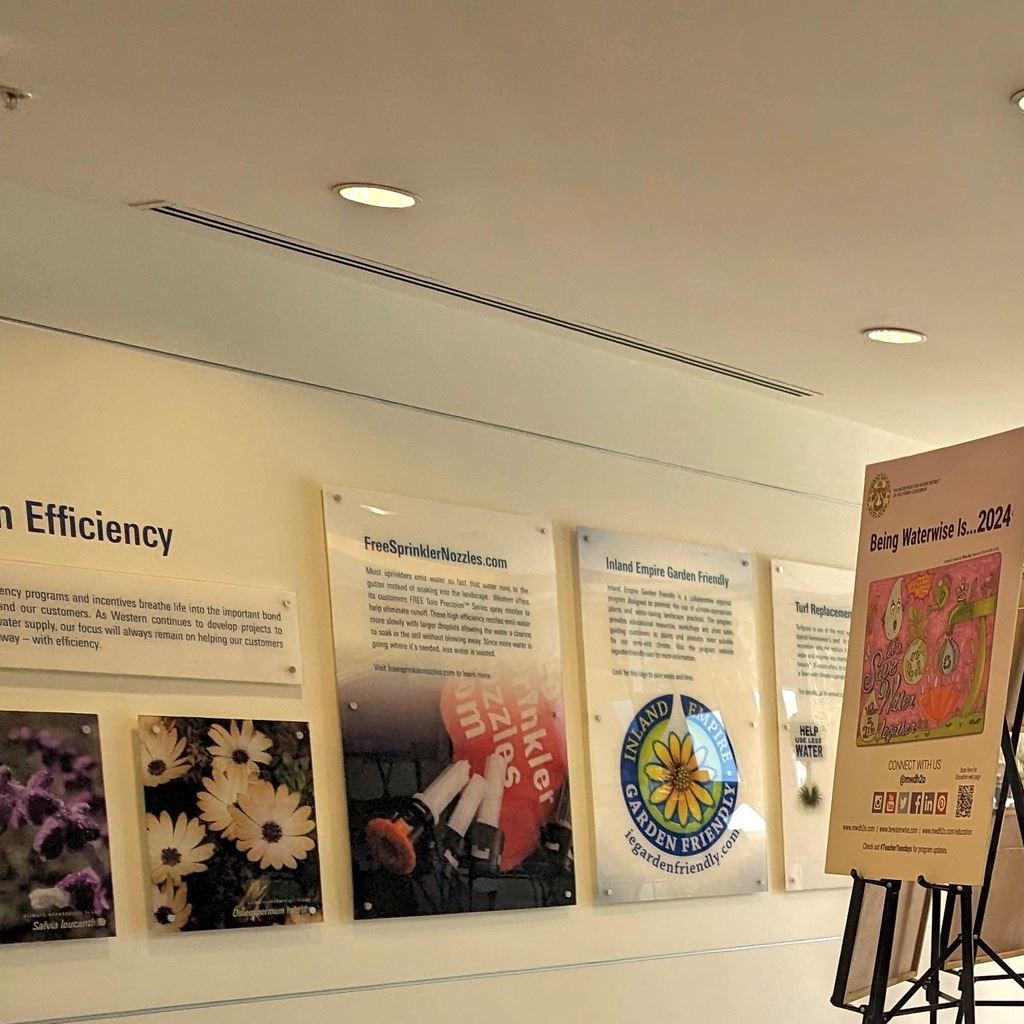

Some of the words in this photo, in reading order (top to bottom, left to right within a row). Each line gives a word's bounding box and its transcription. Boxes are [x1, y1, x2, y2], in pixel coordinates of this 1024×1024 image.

[25, 500, 173, 556] Efficiency
[870, 531, 899, 553] Being
[902, 521, 954, 547] Waterwise
[957, 503, 1012, 536] Is...2024
[364, 536, 508, 569] FreeSprinklerNozzles.com
[606, 557, 633, 572] Inland
[636, 562, 664, 577] Empire
[667, 566, 695, 581] Garden
[698, 571, 728, 588] Friendly
[20, 605, 36, 613] our
[40, 607, 91, 617] customers.
[95, 609, 106, 619] As
[110, 611, 147, 622] Western
[151, 617, 191, 626] continues
[195, 619, 203, 628] to
[207, 620, 237, 631] develop
[241, 623, 271, 633] projects
[274, 626, 282, 634] to
[25, 590, 69, 601] programs
[72, 594, 89, 603] and
[92, 595, 136, 607] incentives
[138, 599, 170, 610] breathe
[173, 602, 186, 612] life
[189, 604, 204, 613] into
[207, 606, 219, 615] the
[222, 607, 259, 618] important
[262, 611, 281, 620] bond
[795, 601, 808, 613] Turf
[811, 604, 852, 619] Replacemen
[24, 620, 57, 631] supply,
[60, 623, 75, 631] our
[78, 623, 102, 633] focus
[104, 625, 120, 634] will
[123, 627, 152, 638] always
[154, 631, 183, 639] remain
[197, 633, 227, 645] helping
[244, 638, 283, 647] customers
[31, 635, 53, 644] with
[55, 636, 101, 649] efficiency.
[624, 701, 669, 762] INLAND
[688, 702, 732, 762] EMPIRE
[795, 737, 806, 745] USE
[799, 726, 818, 738] HELP
[795, 745, 822, 757] WATER
[888, 760, 915, 770] CONNECT
[916, 759, 931, 769] WITH
[932, 759, 941, 769] US
[625, 783, 677, 852] GARDEN
[681, 782, 736, 853] FRIENDLY
[624, 828, 741, 875] iegardenfriendly.com
[32, 921, 58, 931] Salvia
[60, 918, 96, 929] leucanth
